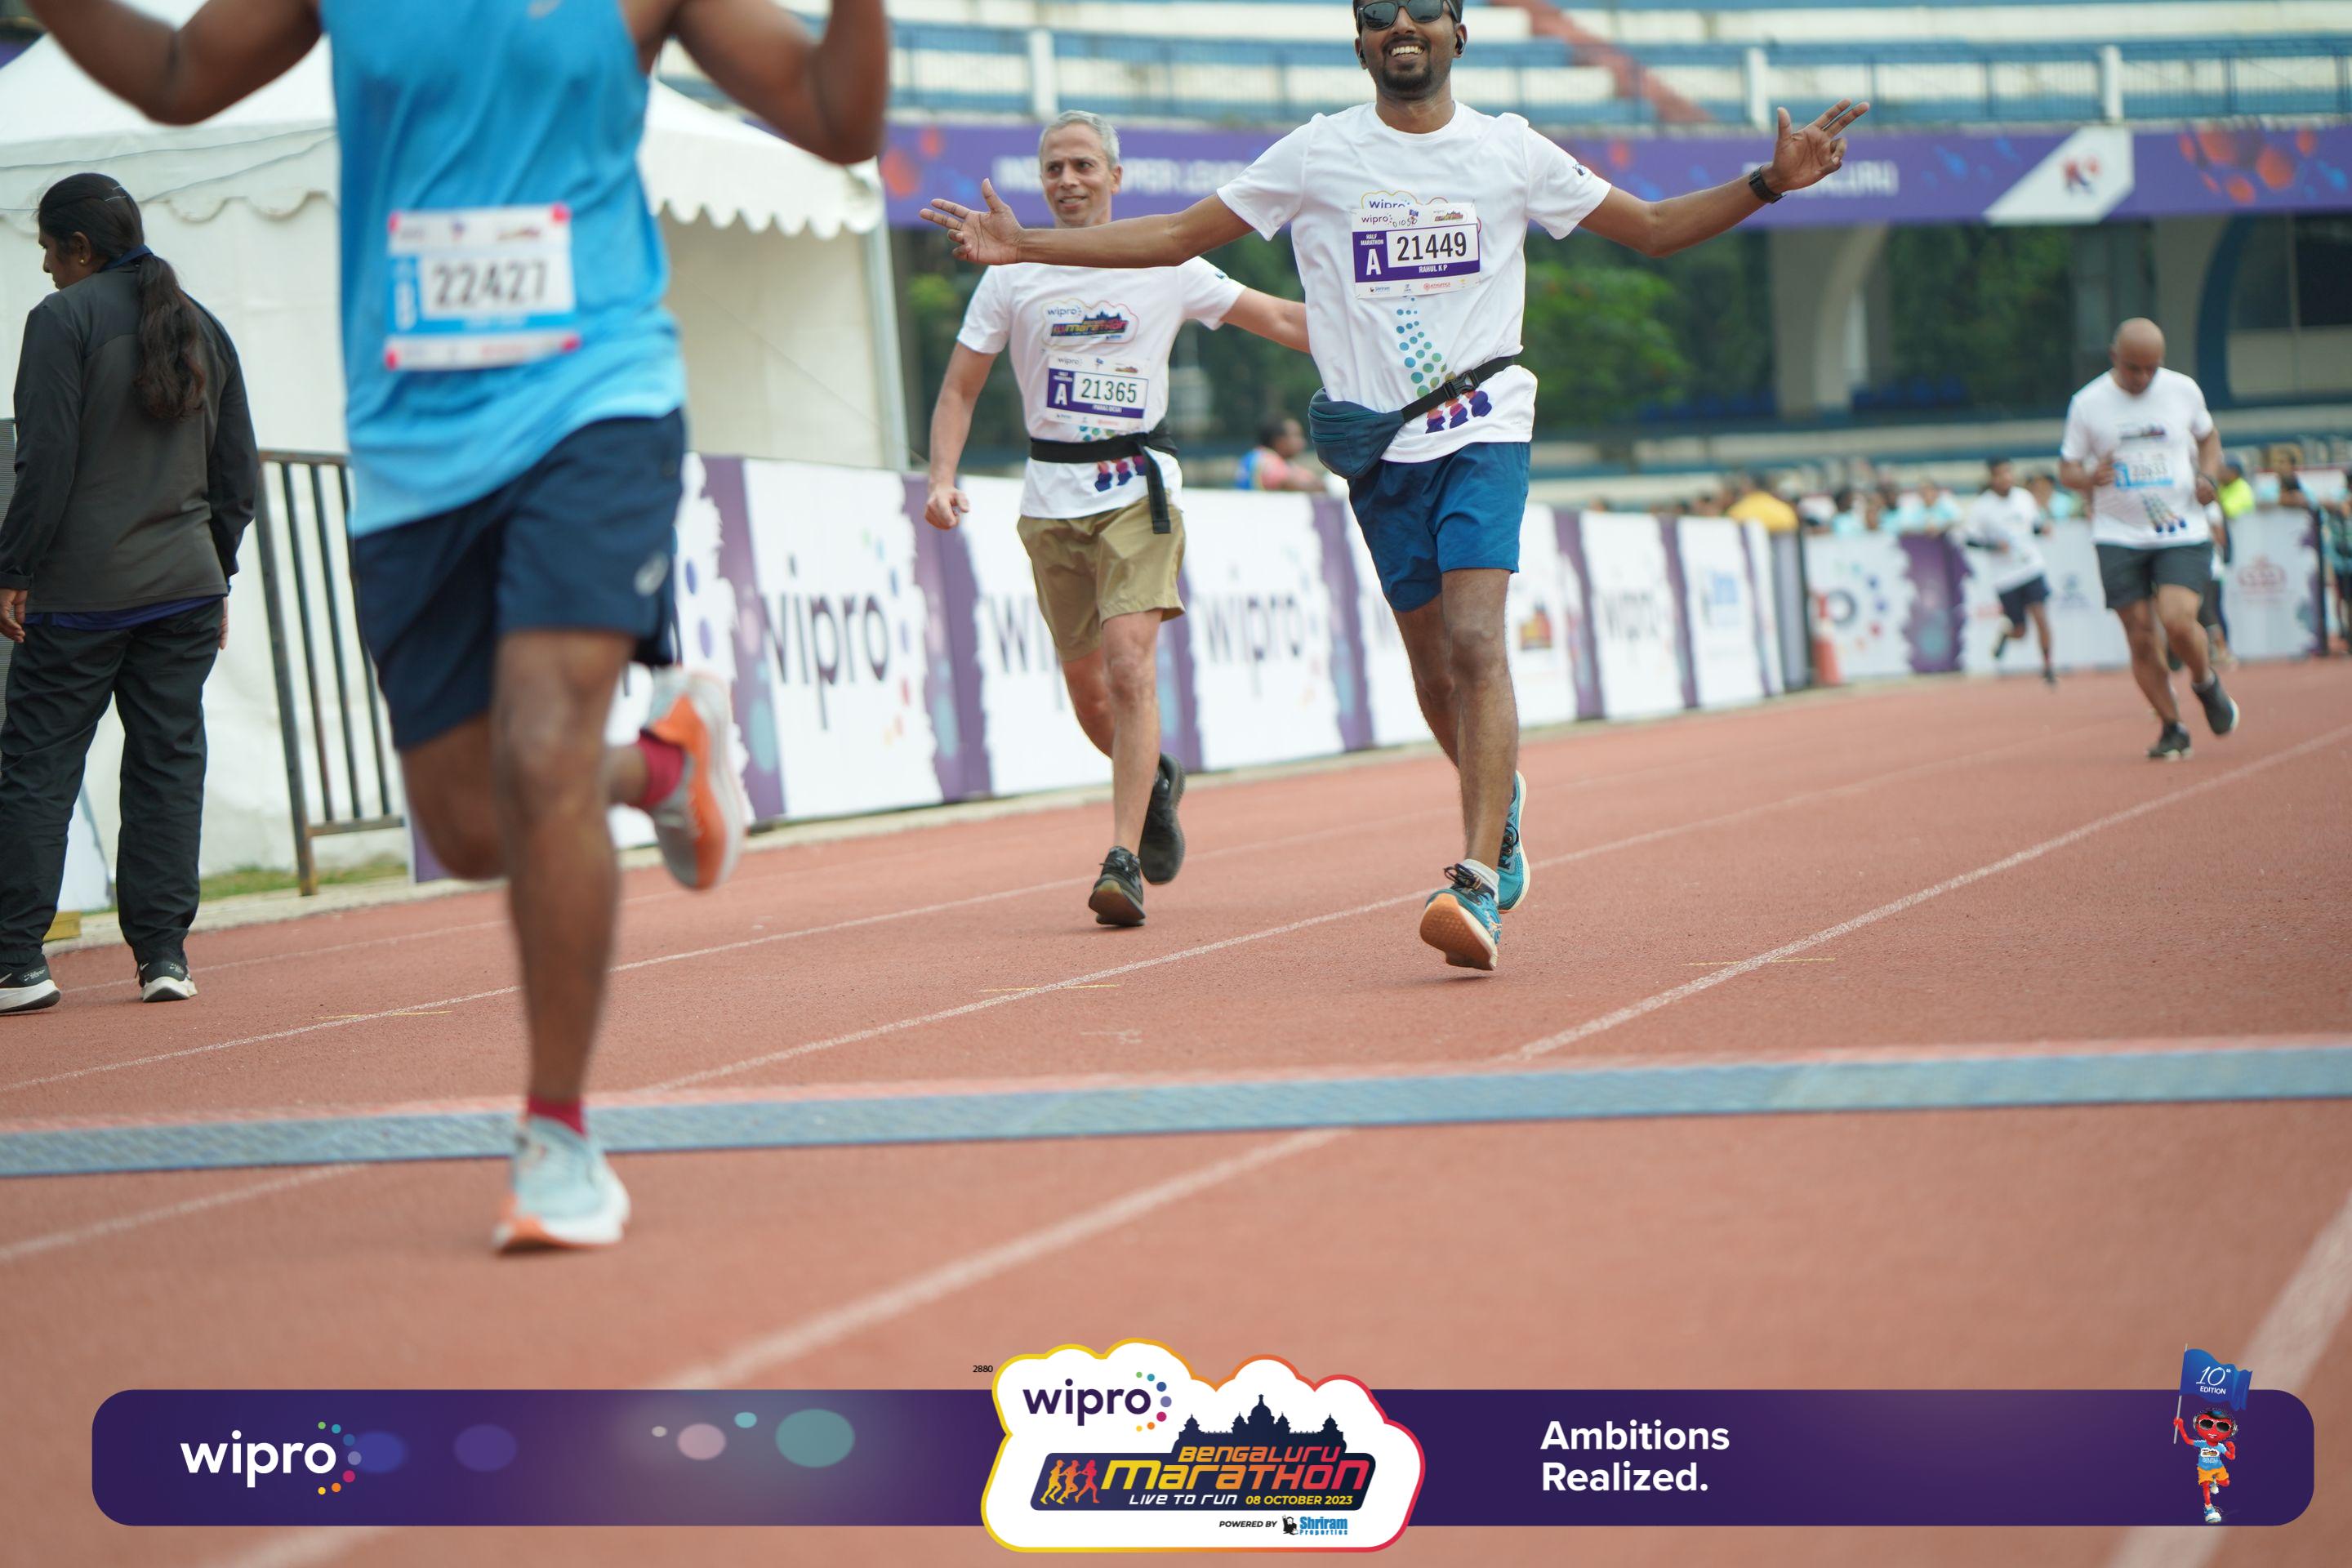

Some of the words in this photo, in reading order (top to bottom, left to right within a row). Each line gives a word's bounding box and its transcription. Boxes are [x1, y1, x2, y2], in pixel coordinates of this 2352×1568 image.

[1361, 215, 1388, 225] wipro
[1366, 248, 1382, 275] A
[1396, 231, 1467, 261] 21449
[1419, 265, 1437, 273] RAHUL
[433, 258, 547, 310] 22427
[1047, 306, 1076, 317] wipro
[1054, 383, 1067, 406] A
[1081, 378, 1137, 403] 21365
